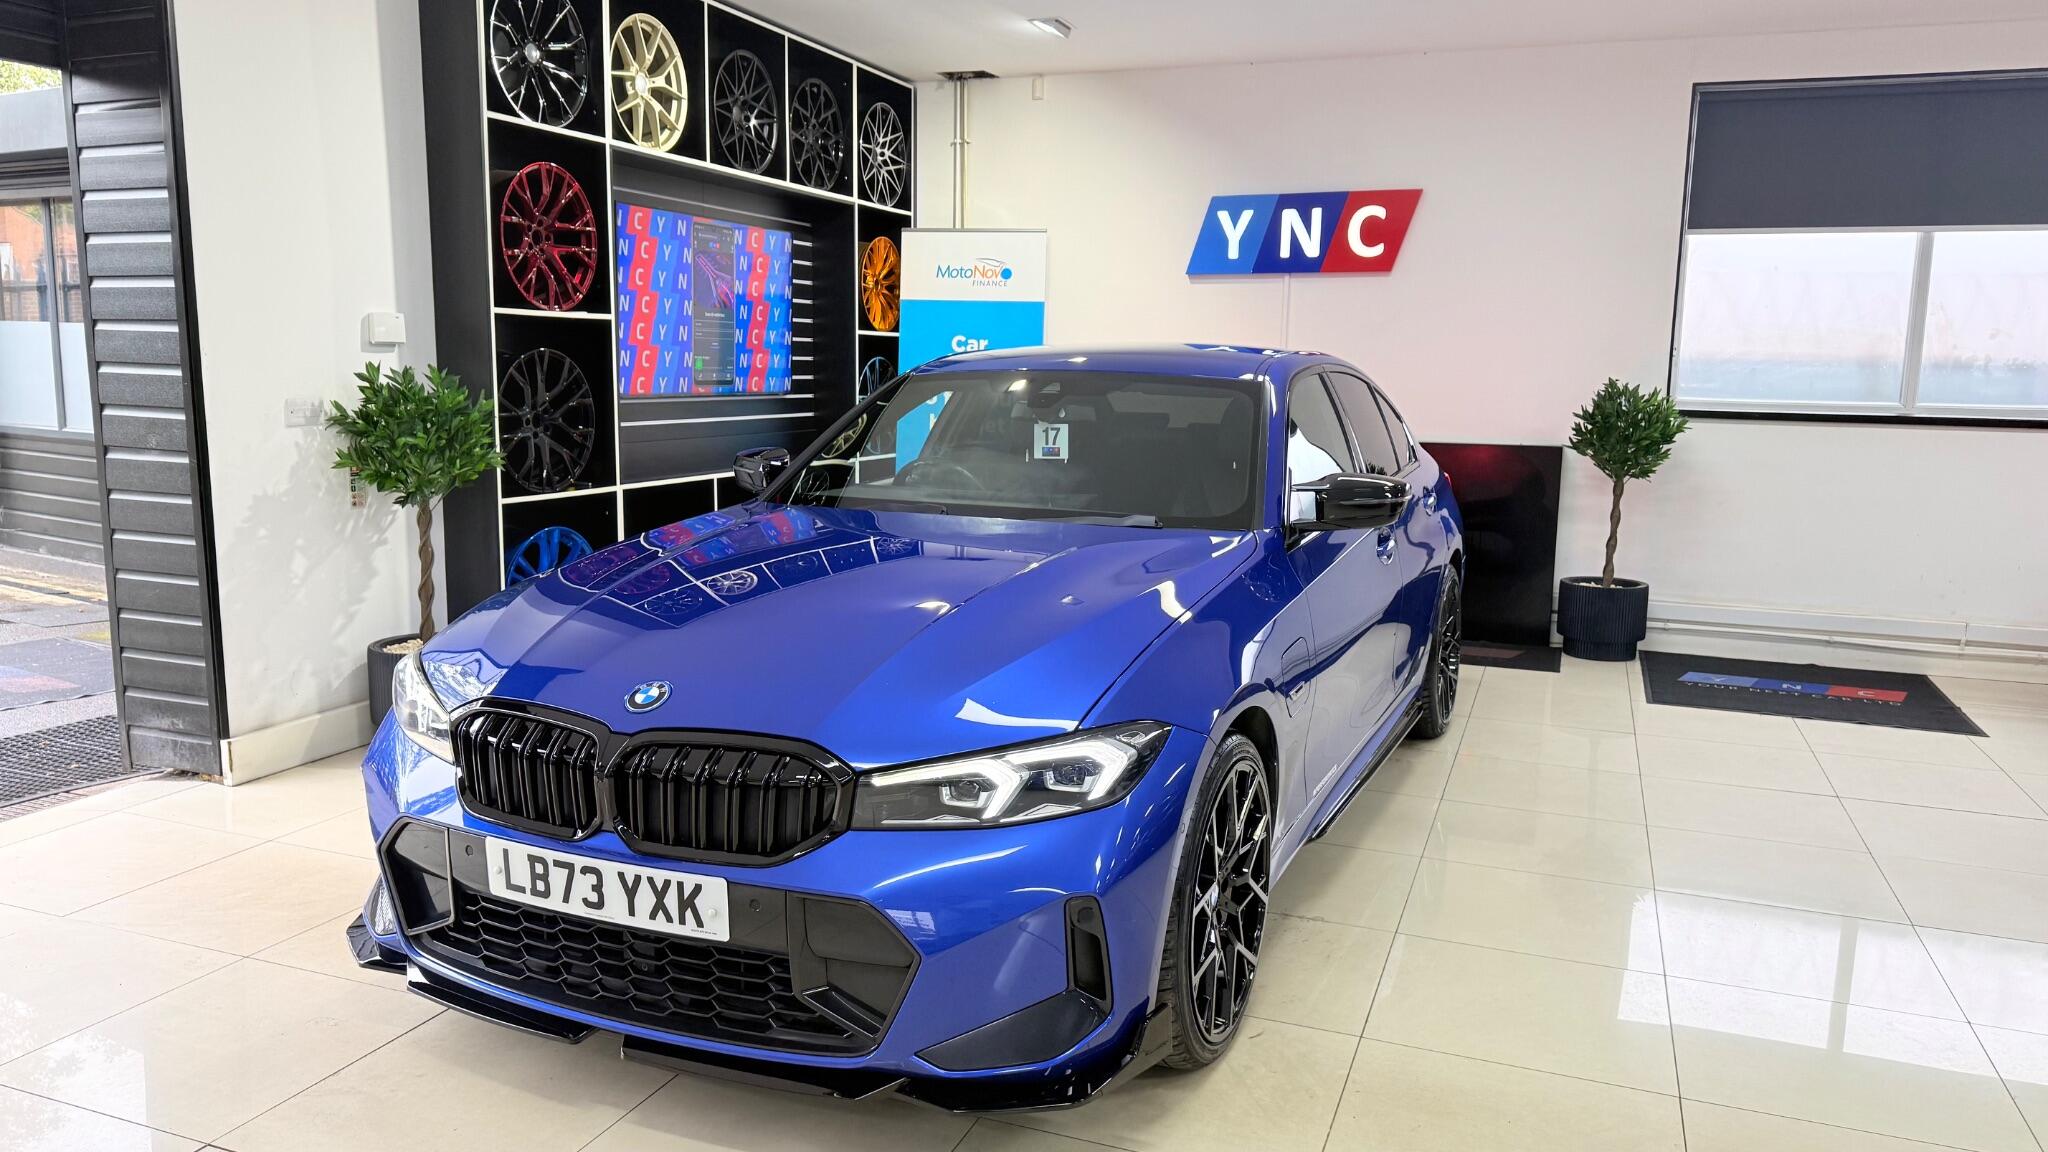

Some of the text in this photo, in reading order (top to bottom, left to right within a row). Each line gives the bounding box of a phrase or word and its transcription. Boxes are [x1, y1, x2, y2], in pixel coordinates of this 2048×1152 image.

[1216, 204, 1388, 260] YNC
[936, 264, 1013, 280] MotoNovo
[951, 335, 989, 351] Car
[1042, 426, 1061, 446] 17
[502, 848, 705, 928] LB73 YXK
